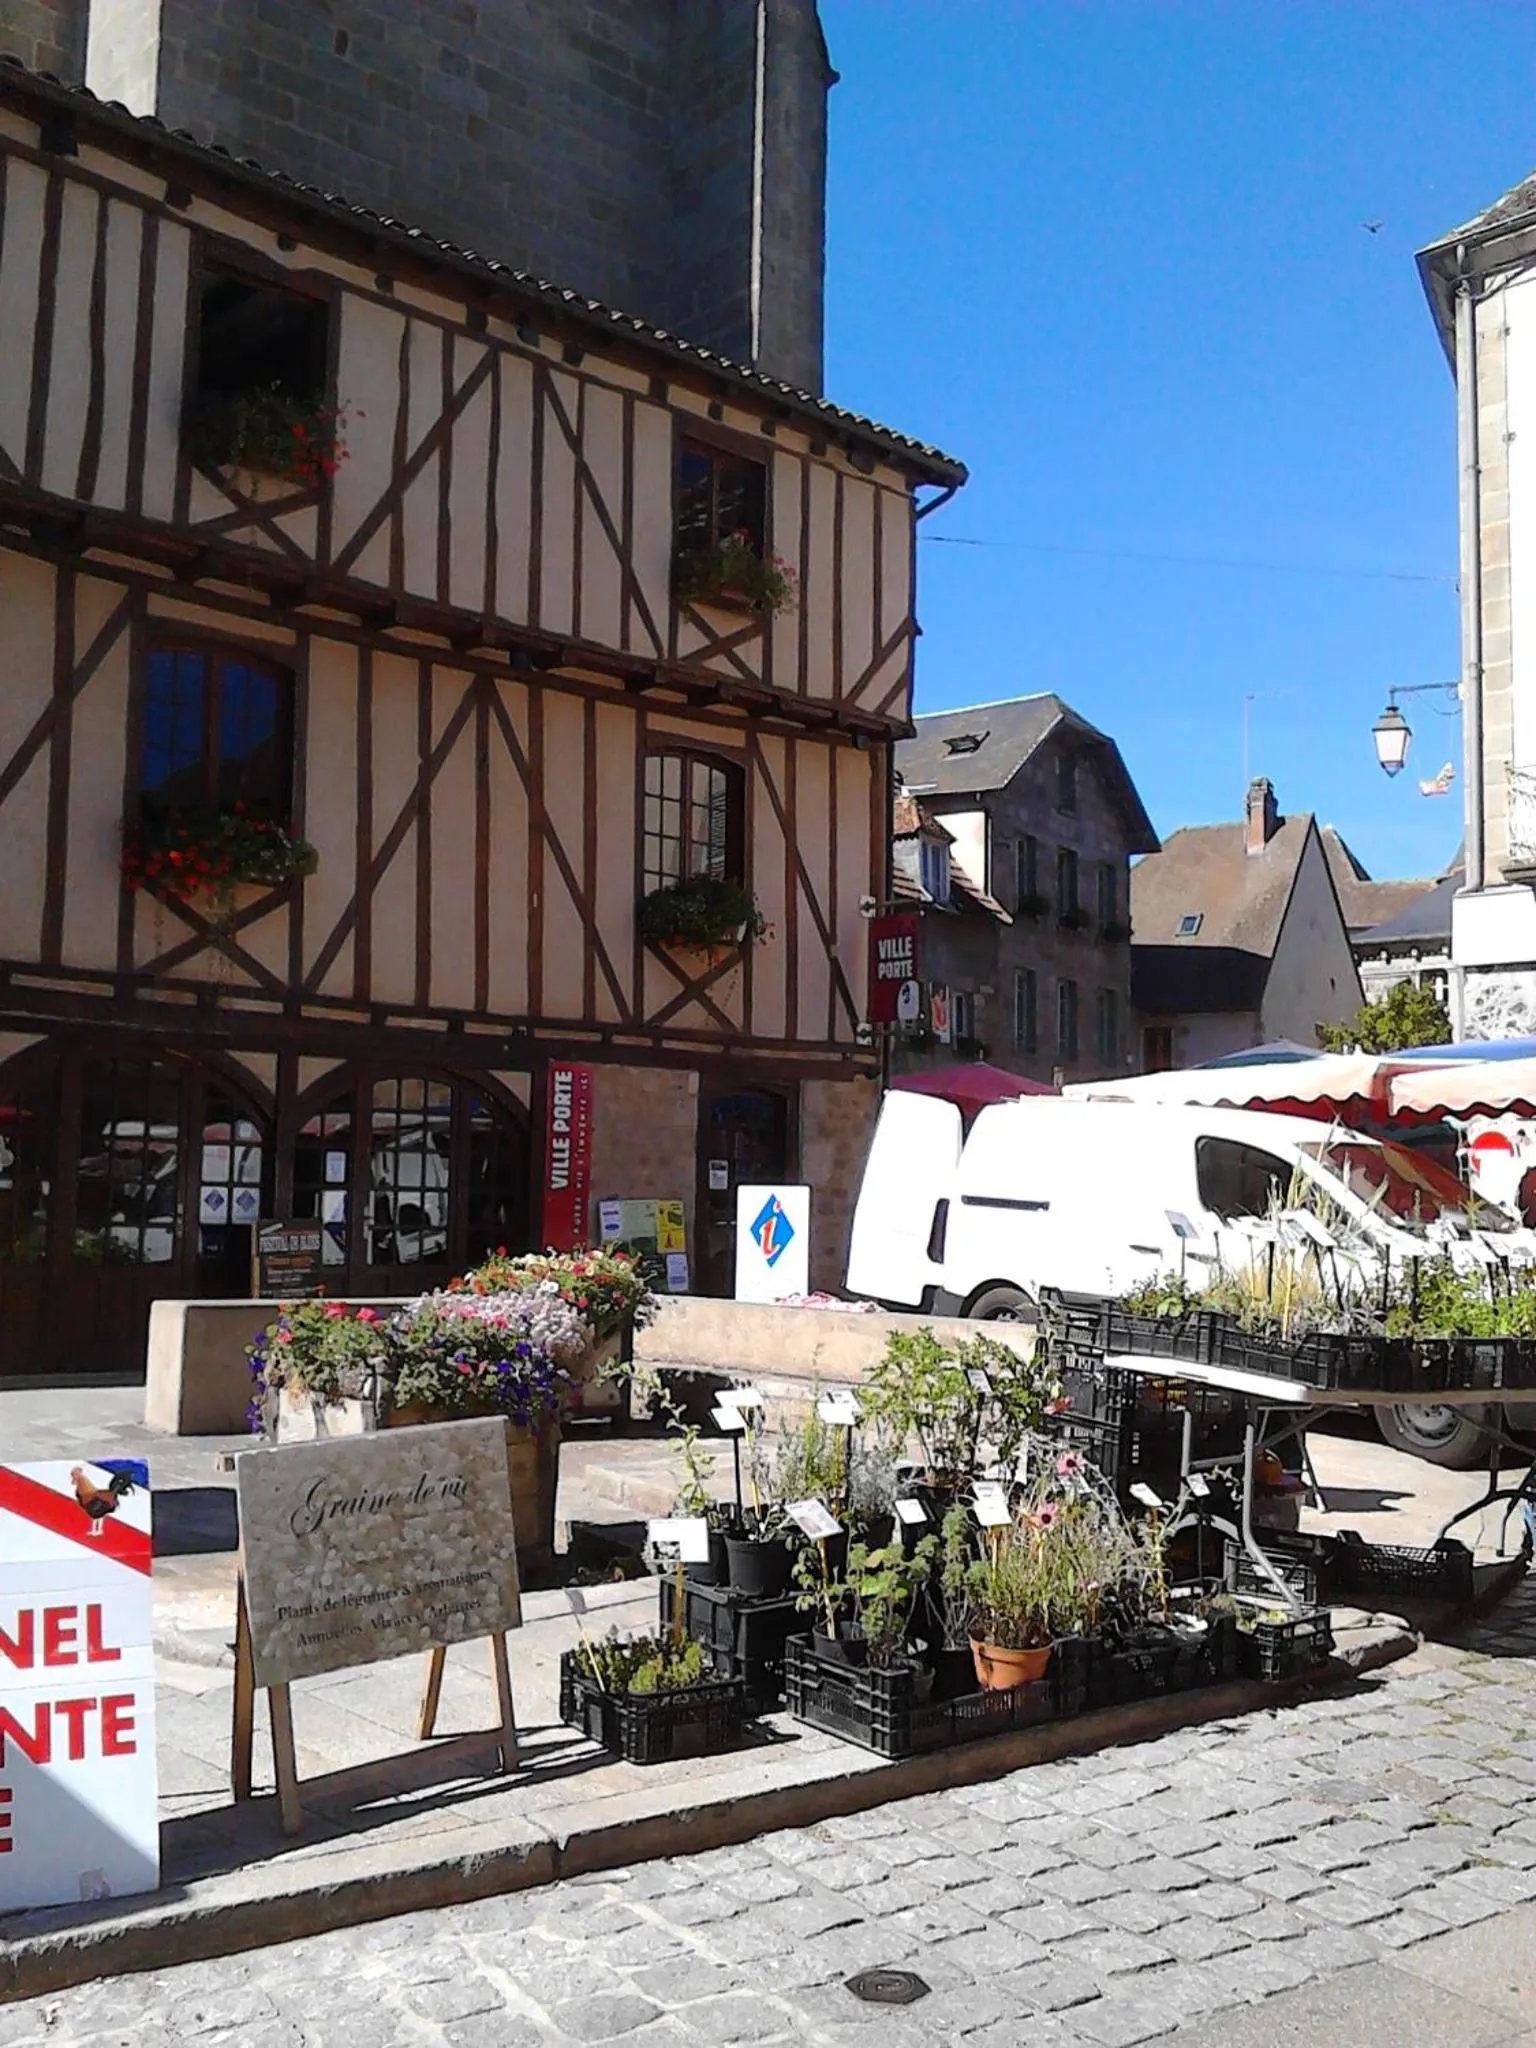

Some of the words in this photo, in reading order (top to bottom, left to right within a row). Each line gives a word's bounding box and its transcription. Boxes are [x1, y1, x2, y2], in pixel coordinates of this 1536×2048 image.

[878, 936, 913, 960] VILLE
[878, 960, 913, 979] PORTE
[552, 1071, 573, 1133] PORTE
[551, 1137, 571, 1190] VILLE
[289, 1475, 400, 1539] Graine
[408, 1472, 436, 1504] de
[277, 1603, 320, 1620] Plants
[322, 1597, 340, 1613] de
